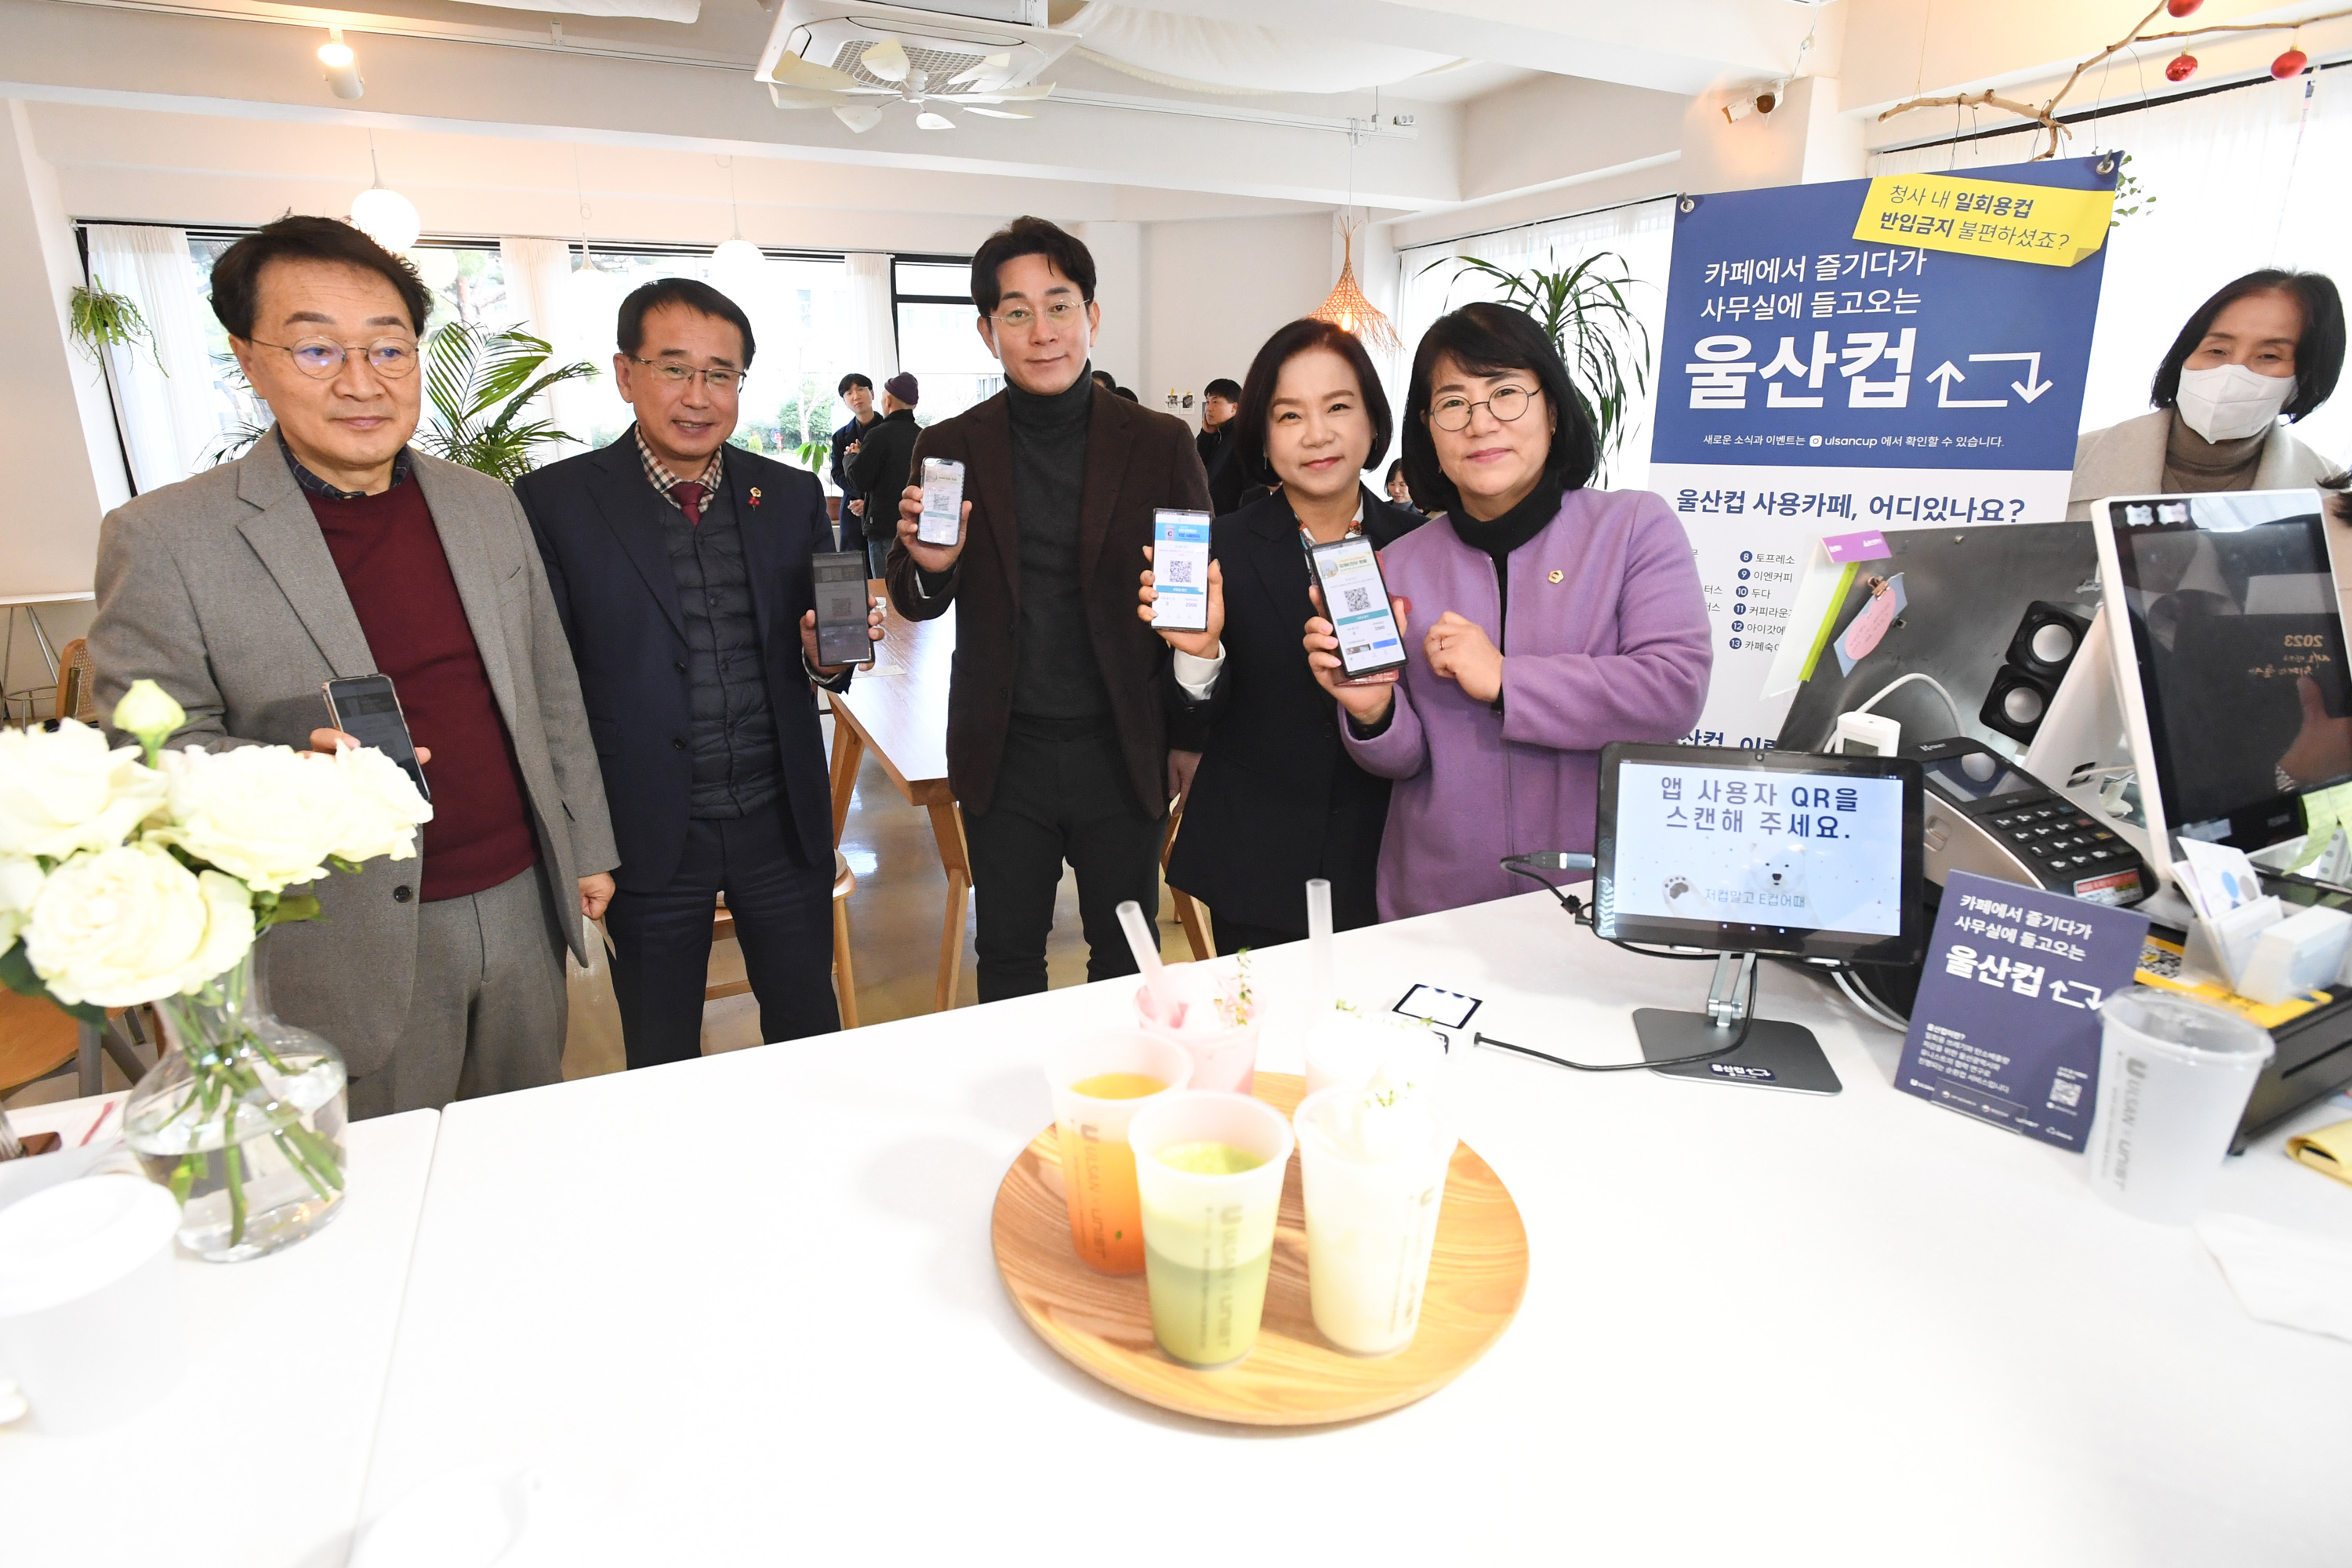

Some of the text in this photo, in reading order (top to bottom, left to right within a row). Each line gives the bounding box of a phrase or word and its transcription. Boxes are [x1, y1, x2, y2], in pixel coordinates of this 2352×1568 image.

[1890, 185, 2034, 219] 청사 내 일회용컵
[1880, 212, 2071, 250] 반입금지 불편하셨죠?
[1704, 248, 1927, 287] 카페에서 즐기다가
[1700, 288, 1922, 322] 사무실에 들고오는
[1685, 328, 1917, 409] 울산컵
[1703, 434, 2005, 448] 새로운 소식과 이벤트는 ulsancup 에서 확인할 수 있습니다.
[1676, 488, 2025, 524] 울산컵 사용카페, 어디있나요?
[1755, 554, 1795, 564] 토프레소
[1737, 586, 1771, 599] 10 두다
[1754, 571, 1793, 583] 이엔커피
[1735, 604, 1792, 618] 11 커피라운
[1730, 639, 1741, 648] 13
[1732, 622, 1786, 635] 12 아이갓에
[1661, 777, 1858, 812] 앱 사용자 QR을
[1666, 806, 1850, 839] 스캔해 주세요.
[1705, 888, 1755, 904] 저컵말고
[1959, 895, 2092, 940] 카페에서 즐기다가
[1955, 915, 2086, 962] 사무실에 들고오는
[1945, 944, 2045, 998] 울산컵
